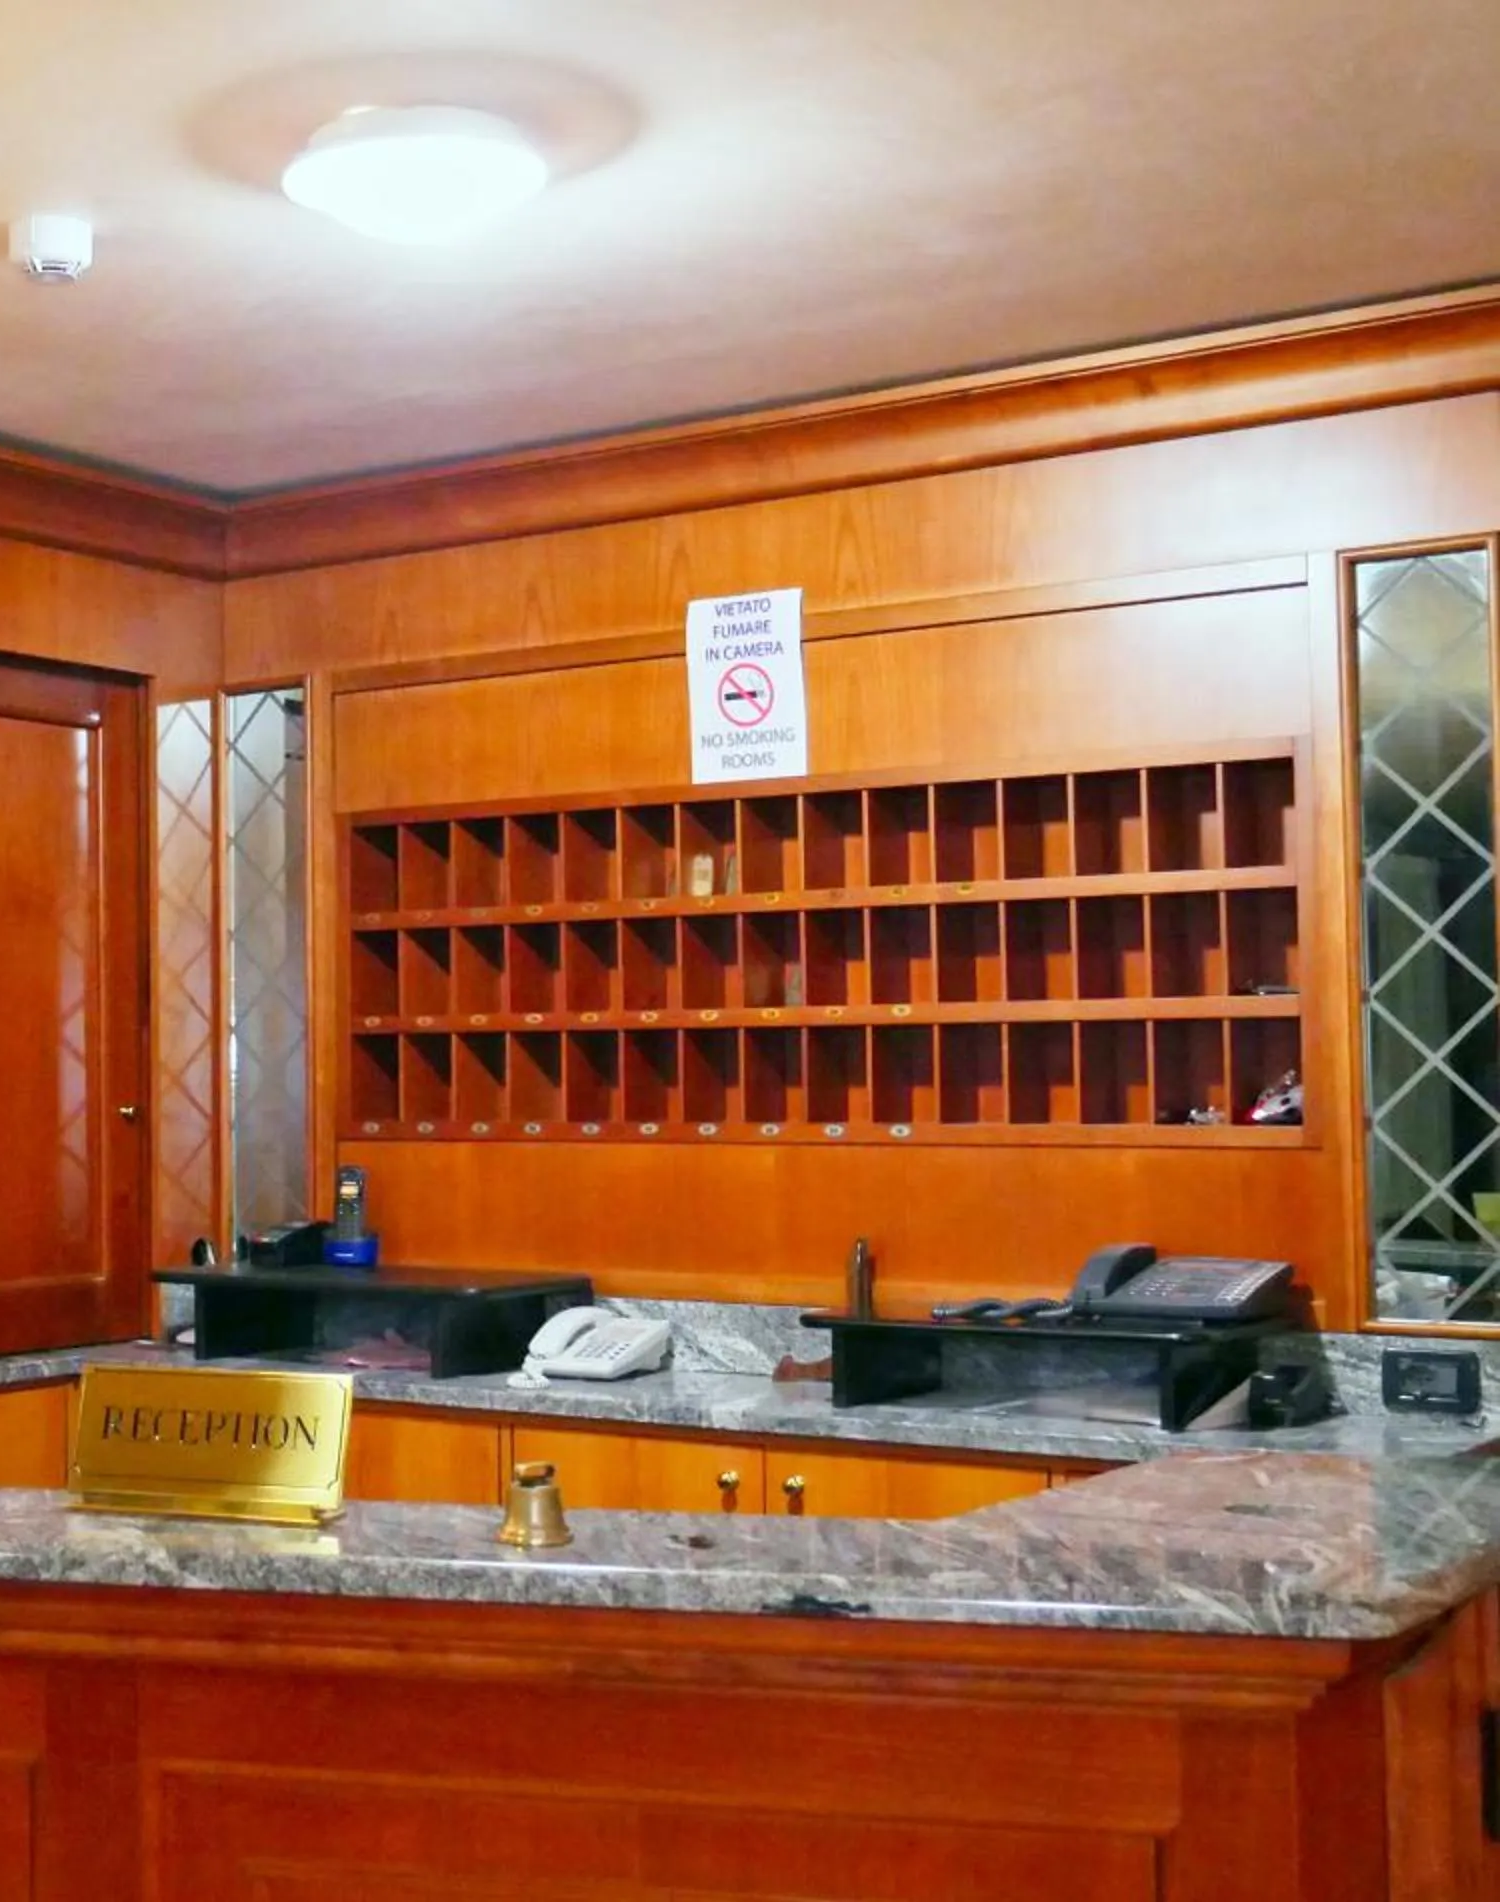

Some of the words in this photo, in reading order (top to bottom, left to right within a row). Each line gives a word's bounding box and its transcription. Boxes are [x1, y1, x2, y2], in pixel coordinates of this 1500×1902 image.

[714, 597, 771, 617] VIETATO
[713, 619, 772, 639] FUMARE
[705, 648, 720, 663] IN
[723, 640, 784, 661] CAMERA
[701, 732, 723, 749] NO
[727, 726, 796, 747] SMOKING
[721, 752, 776, 770] ROOMS
[102, 1404, 320, 1451] RECEPTION
